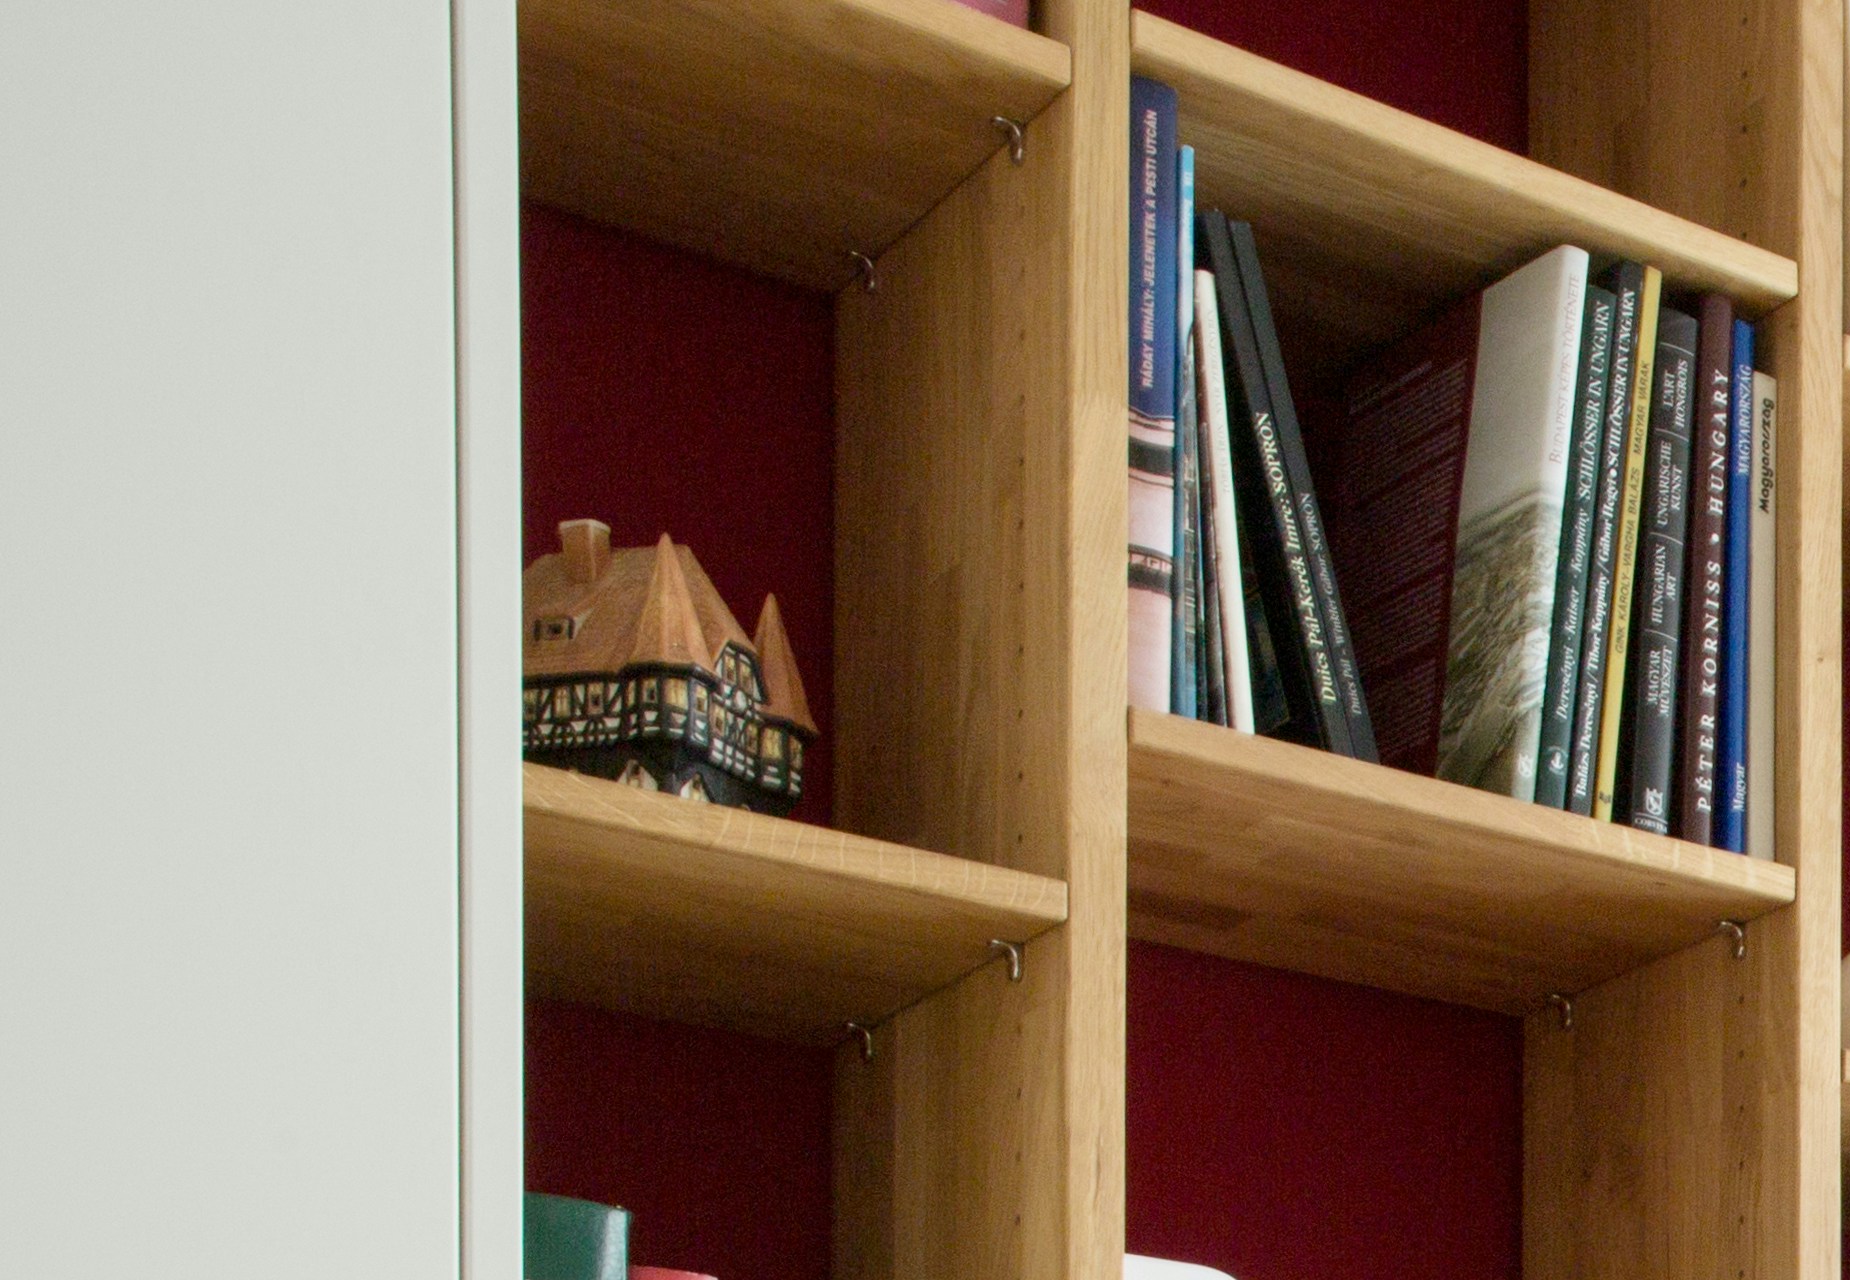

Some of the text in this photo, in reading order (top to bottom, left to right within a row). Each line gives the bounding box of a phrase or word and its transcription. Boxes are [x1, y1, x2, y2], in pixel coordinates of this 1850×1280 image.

[1736, 363, 1752, 477] MAGYARORSZÁG
[1657, 440, 1672, 527] UNGARISCHE
[1664, 572, 1678, 602] ART
[1696, 368, 1730, 812] PÉTER KORNISS HUNGARY
